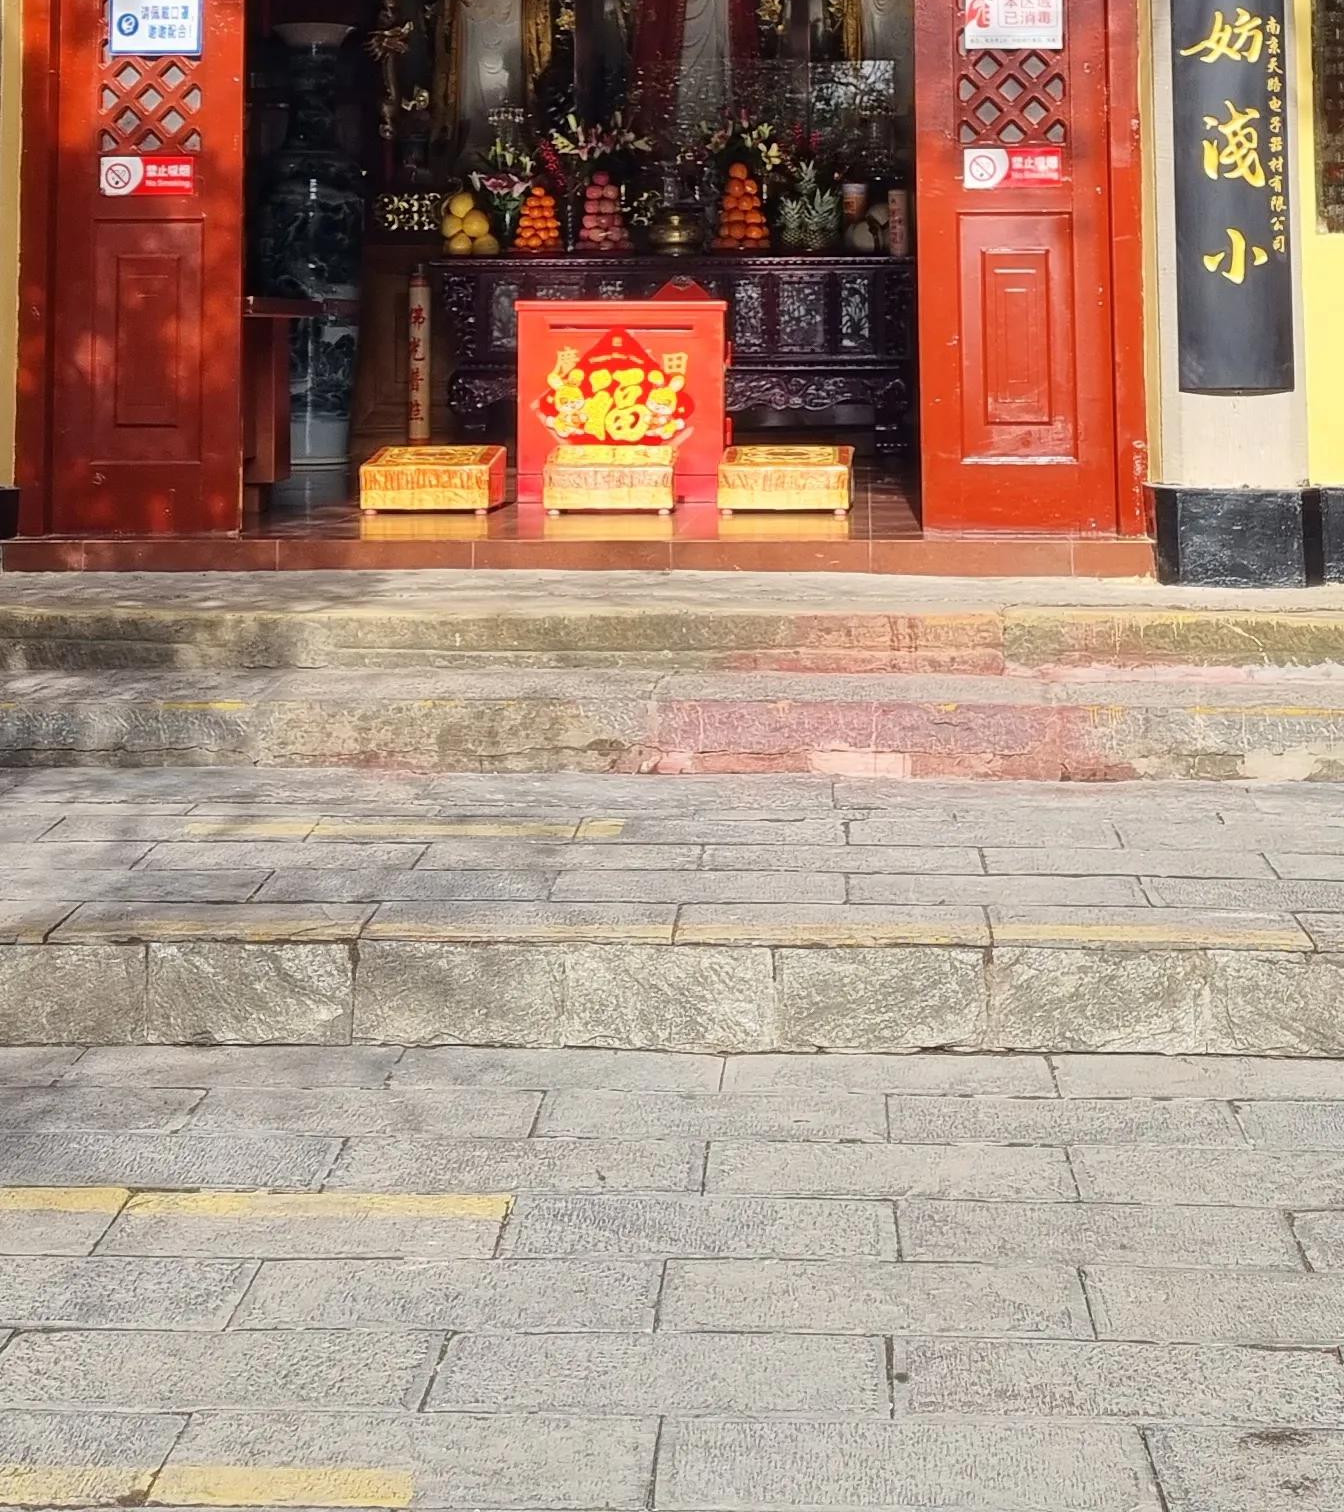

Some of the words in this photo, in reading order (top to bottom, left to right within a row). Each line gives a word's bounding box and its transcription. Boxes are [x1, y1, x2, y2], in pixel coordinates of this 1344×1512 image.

[1004, 10, 1051, 25] 已消毒
[584, 367, 651, 442] 福
